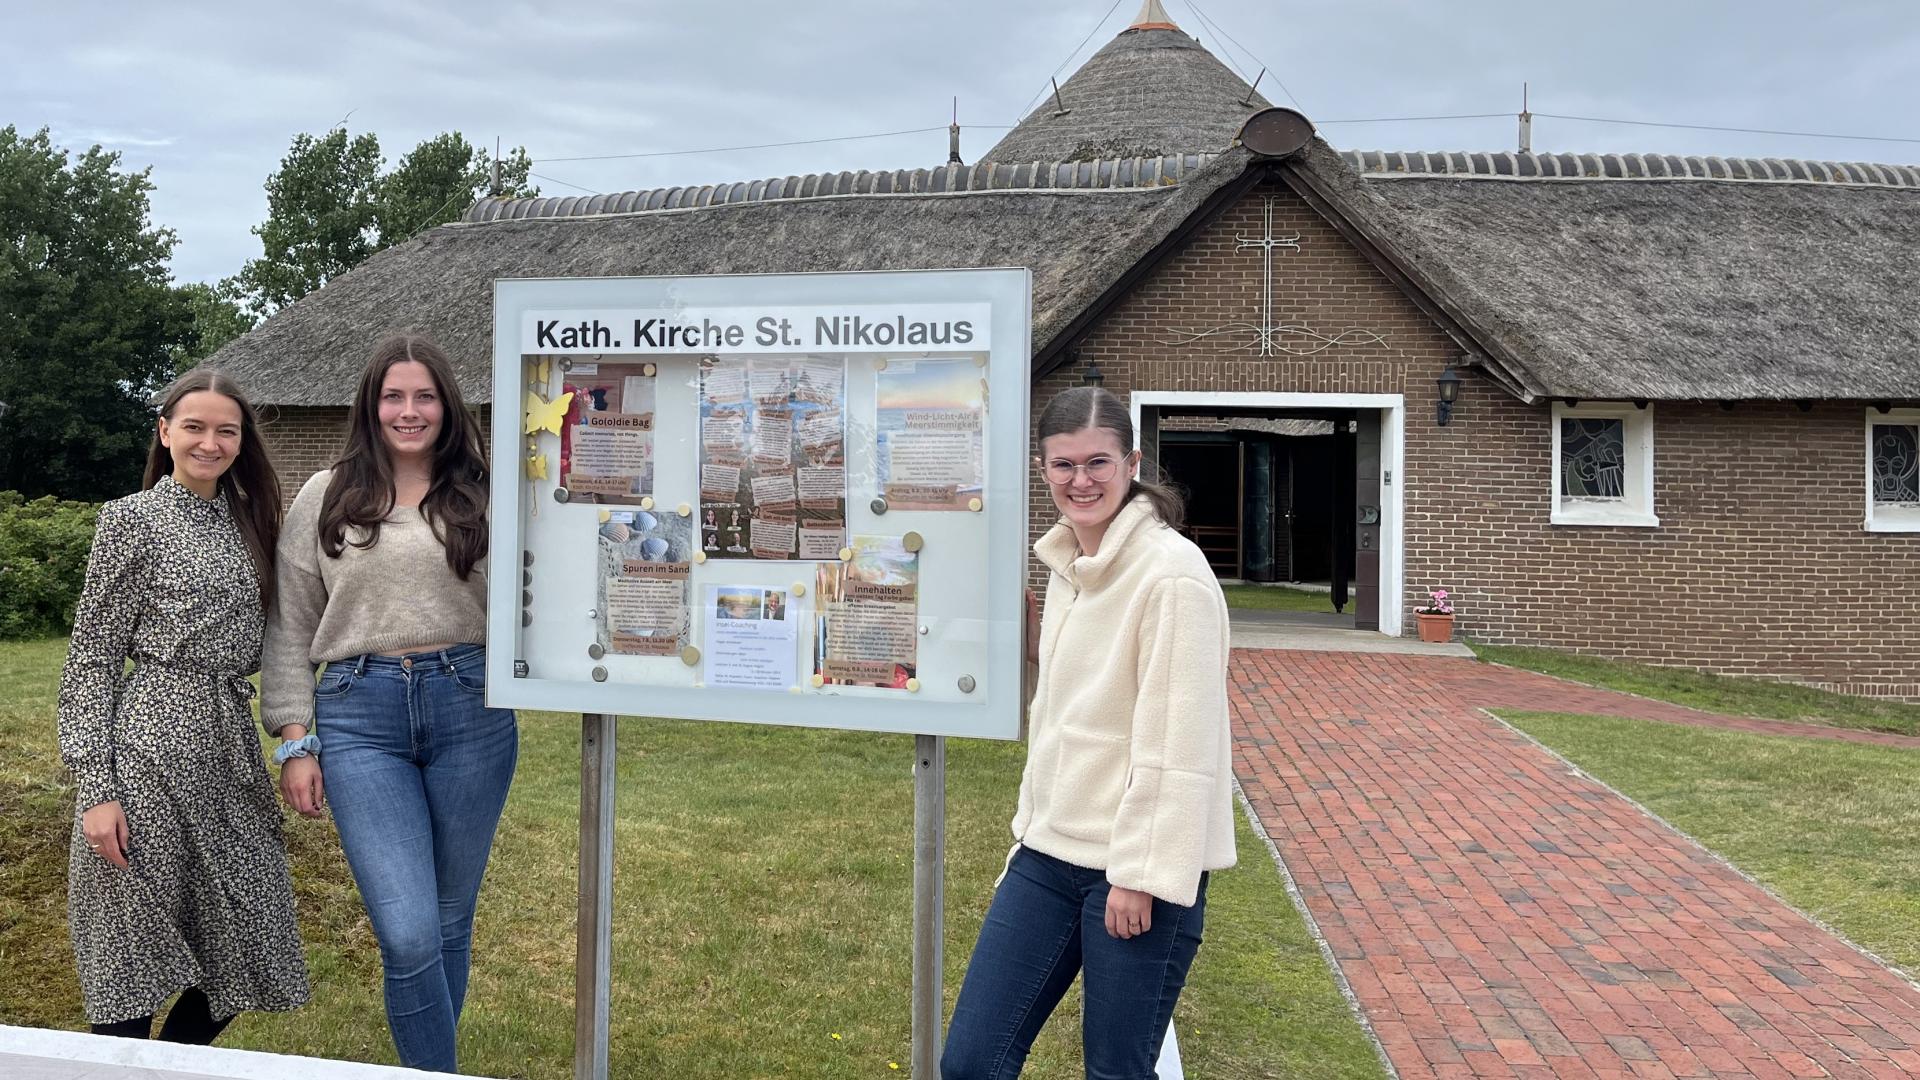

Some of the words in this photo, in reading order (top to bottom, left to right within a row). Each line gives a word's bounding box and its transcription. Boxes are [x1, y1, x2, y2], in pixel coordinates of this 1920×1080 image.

[537, 319, 621, 349] Kath.
[633, 318, 744, 348] Kirche
[755, 316, 801, 346] St.
[815, 315, 973, 345] Nikolaus
[591, 417, 630, 427] Go(o)die
[632, 418, 650, 429] Bag
[905, 420, 979, 430] Meerstimmigkeit
[623, 564, 653, 573] Spuren
[668, 565, 690, 574] Sand
[855, 585, 902, 595] Innehalten
